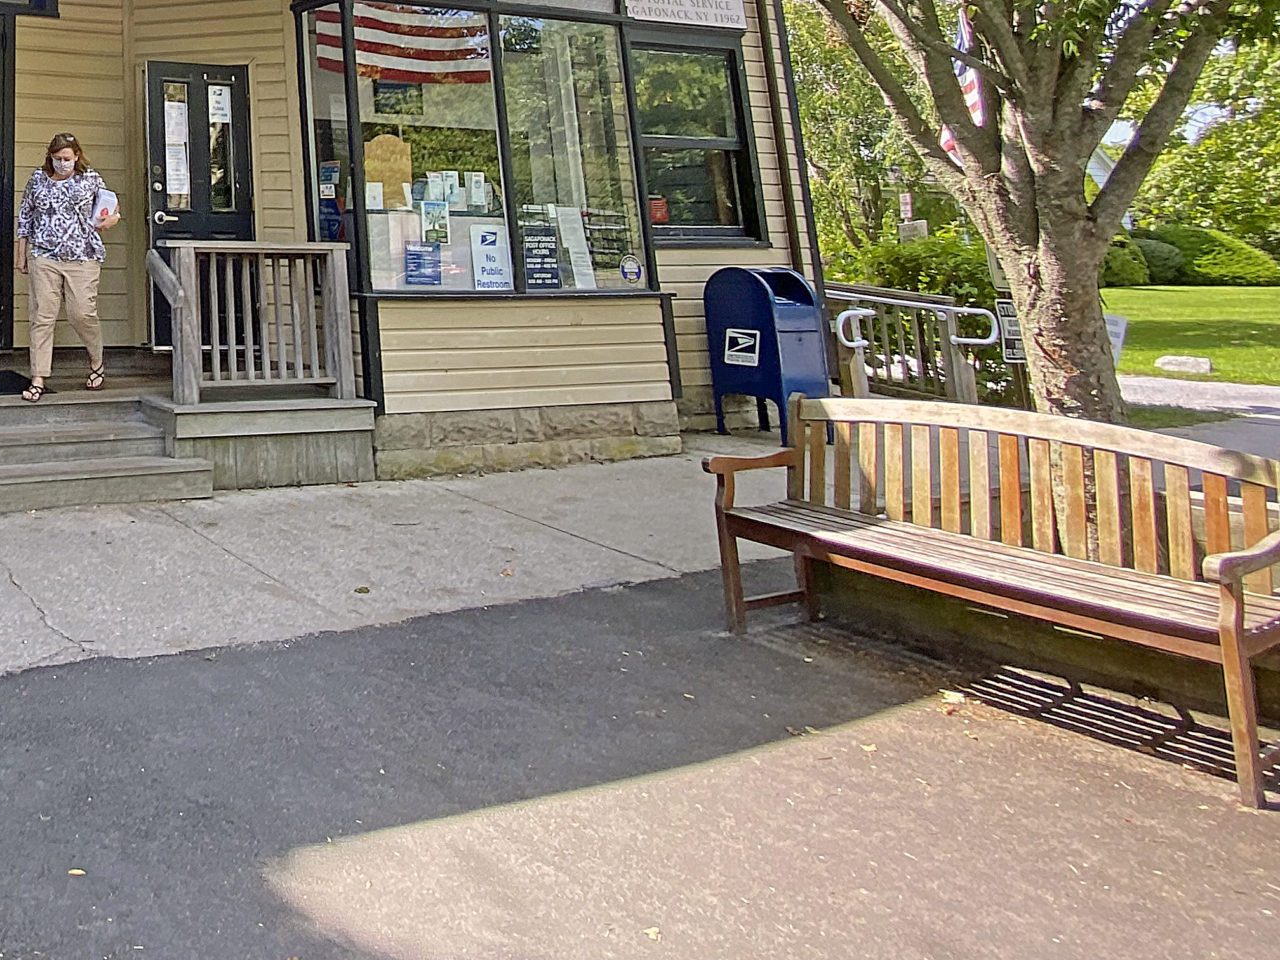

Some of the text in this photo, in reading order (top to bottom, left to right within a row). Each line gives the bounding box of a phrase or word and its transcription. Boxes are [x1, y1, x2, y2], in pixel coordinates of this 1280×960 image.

[695, 10, 709, 22] NY
[713, 13, 741, 25] 11962
[485, 253, 496, 263] No
[481, 266, 503, 276] Public
[476, 279, 510, 289] Restroom
